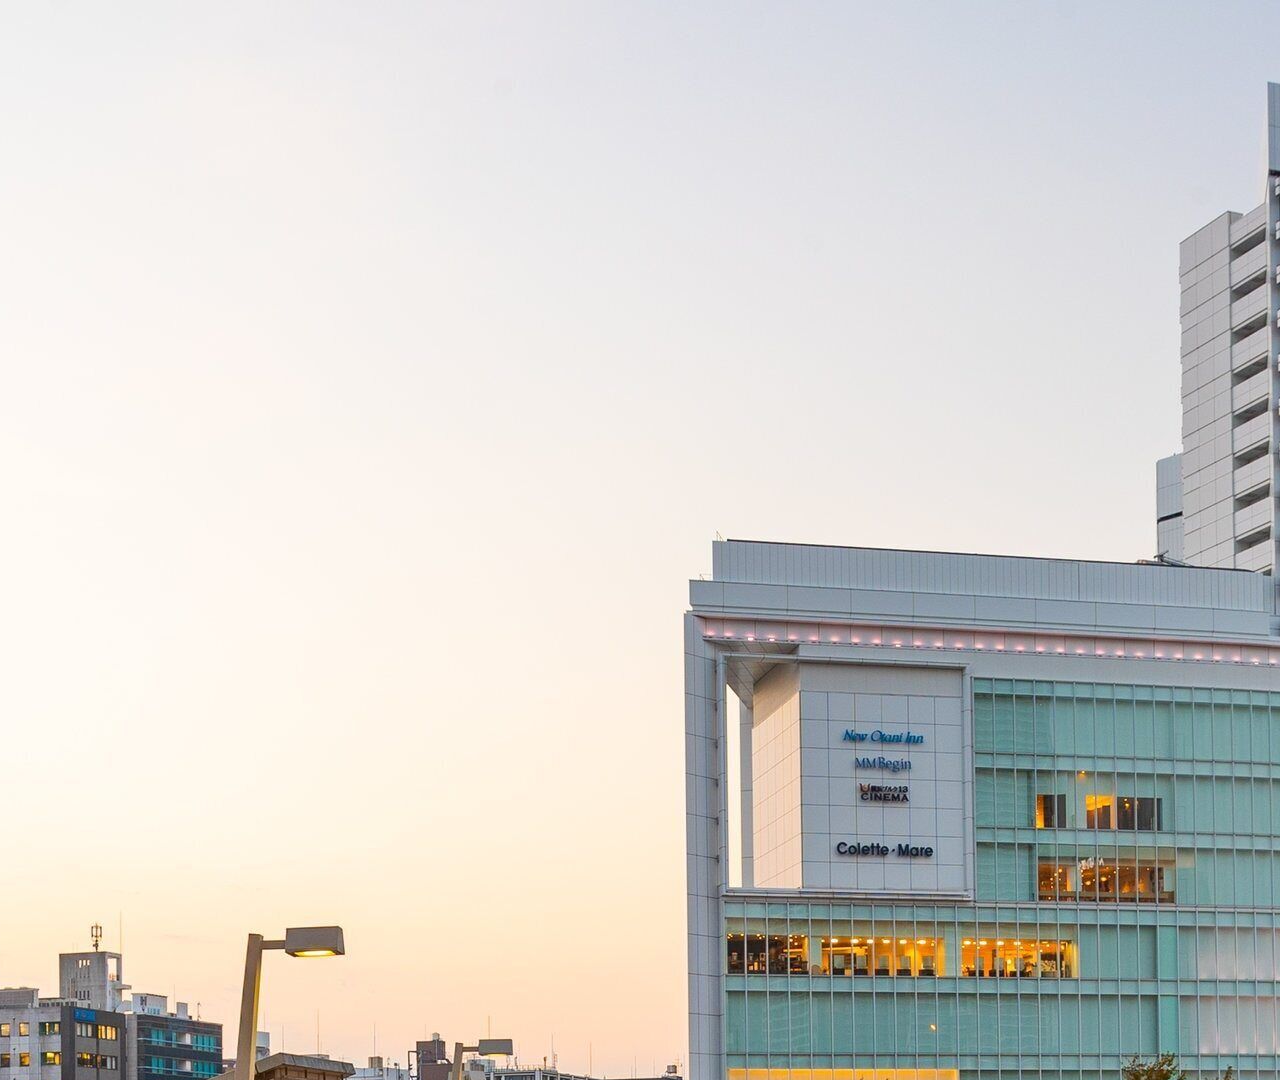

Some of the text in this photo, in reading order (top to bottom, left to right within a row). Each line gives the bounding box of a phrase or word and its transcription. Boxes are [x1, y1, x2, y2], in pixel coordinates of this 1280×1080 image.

[842, 729, 924, 744] New Otani Inn
[860, 792, 910, 801] CINEMA
